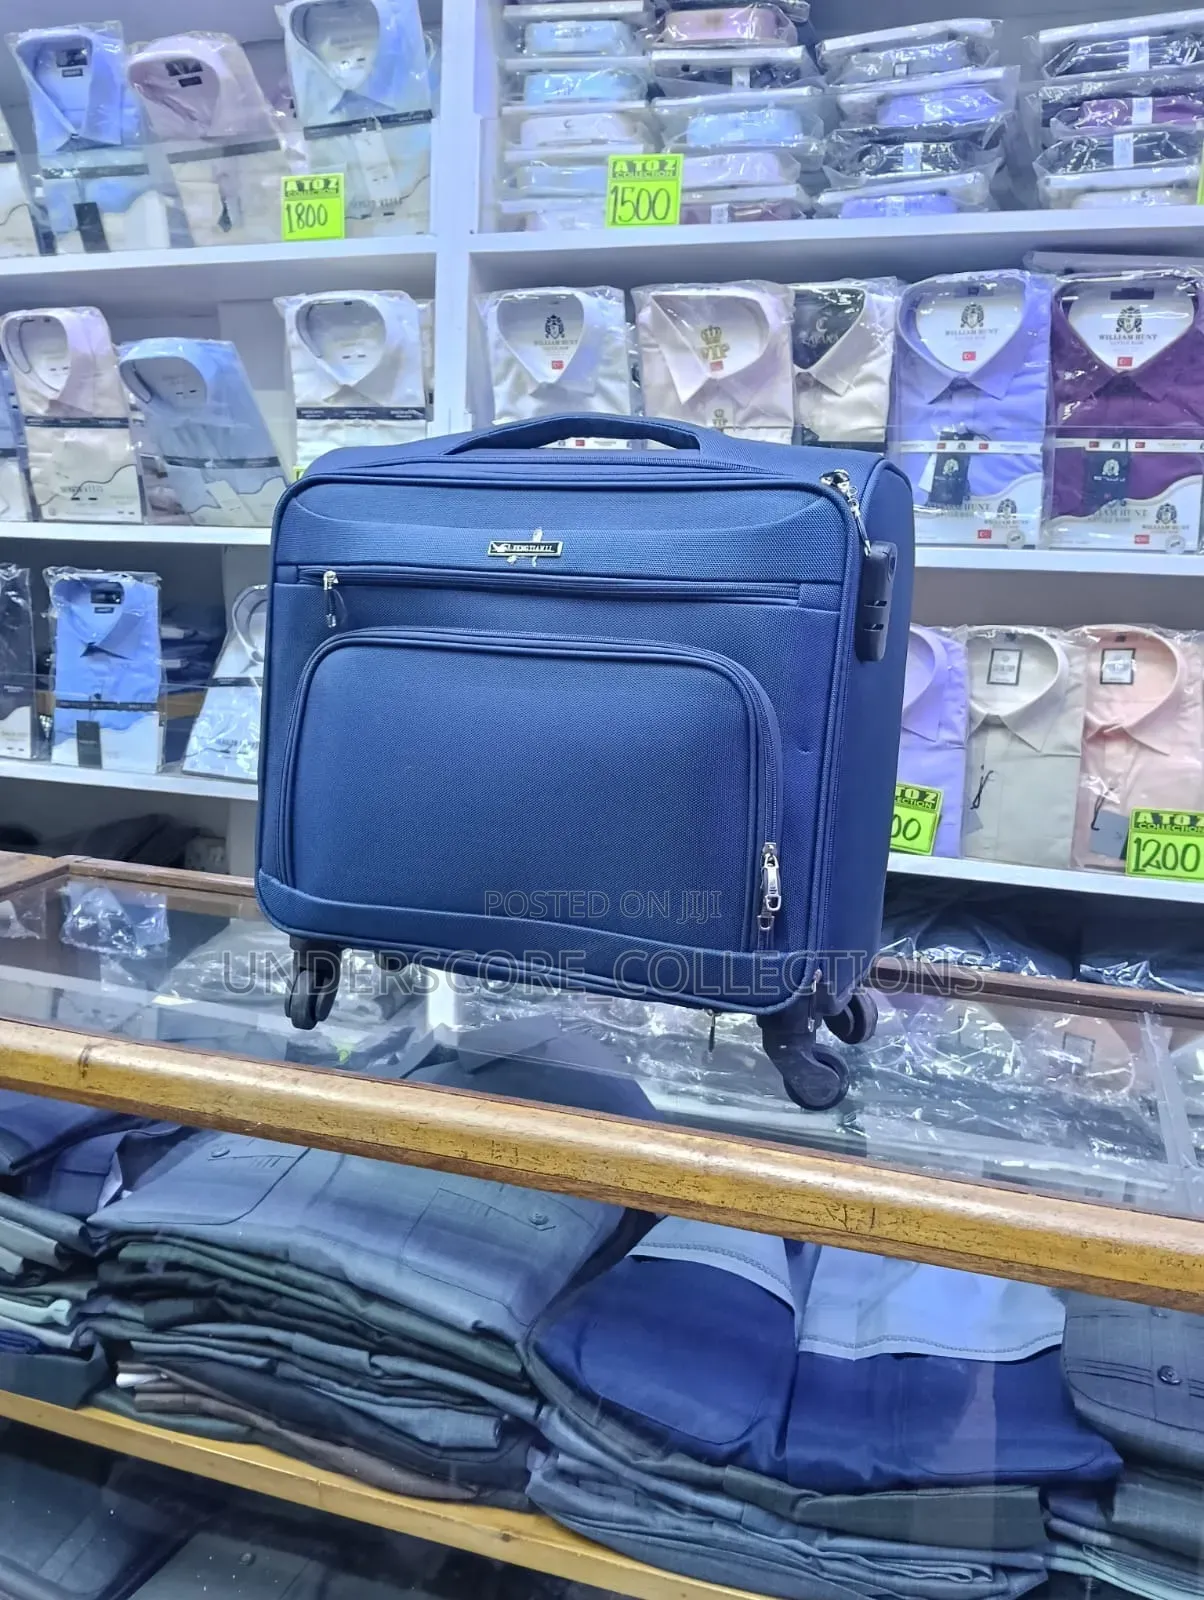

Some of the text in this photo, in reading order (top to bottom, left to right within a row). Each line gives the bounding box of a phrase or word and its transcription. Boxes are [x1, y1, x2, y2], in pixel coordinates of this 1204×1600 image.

[614, 160, 677, 171] A TO Z
[286, 178, 338, 191] A TO Z
[610, 185, 672, 224] 1500
[286, 202, 328, 233] 1800
[896, 797, 933, 809] ECTION
[924, 791, 937, 803] Z
[1136, 812, 1154, 824] A
[1159, 813, 1191, 826] TO
[891, 814, 921, 842] 00
[1132, 837, 1200, 873] 1200
